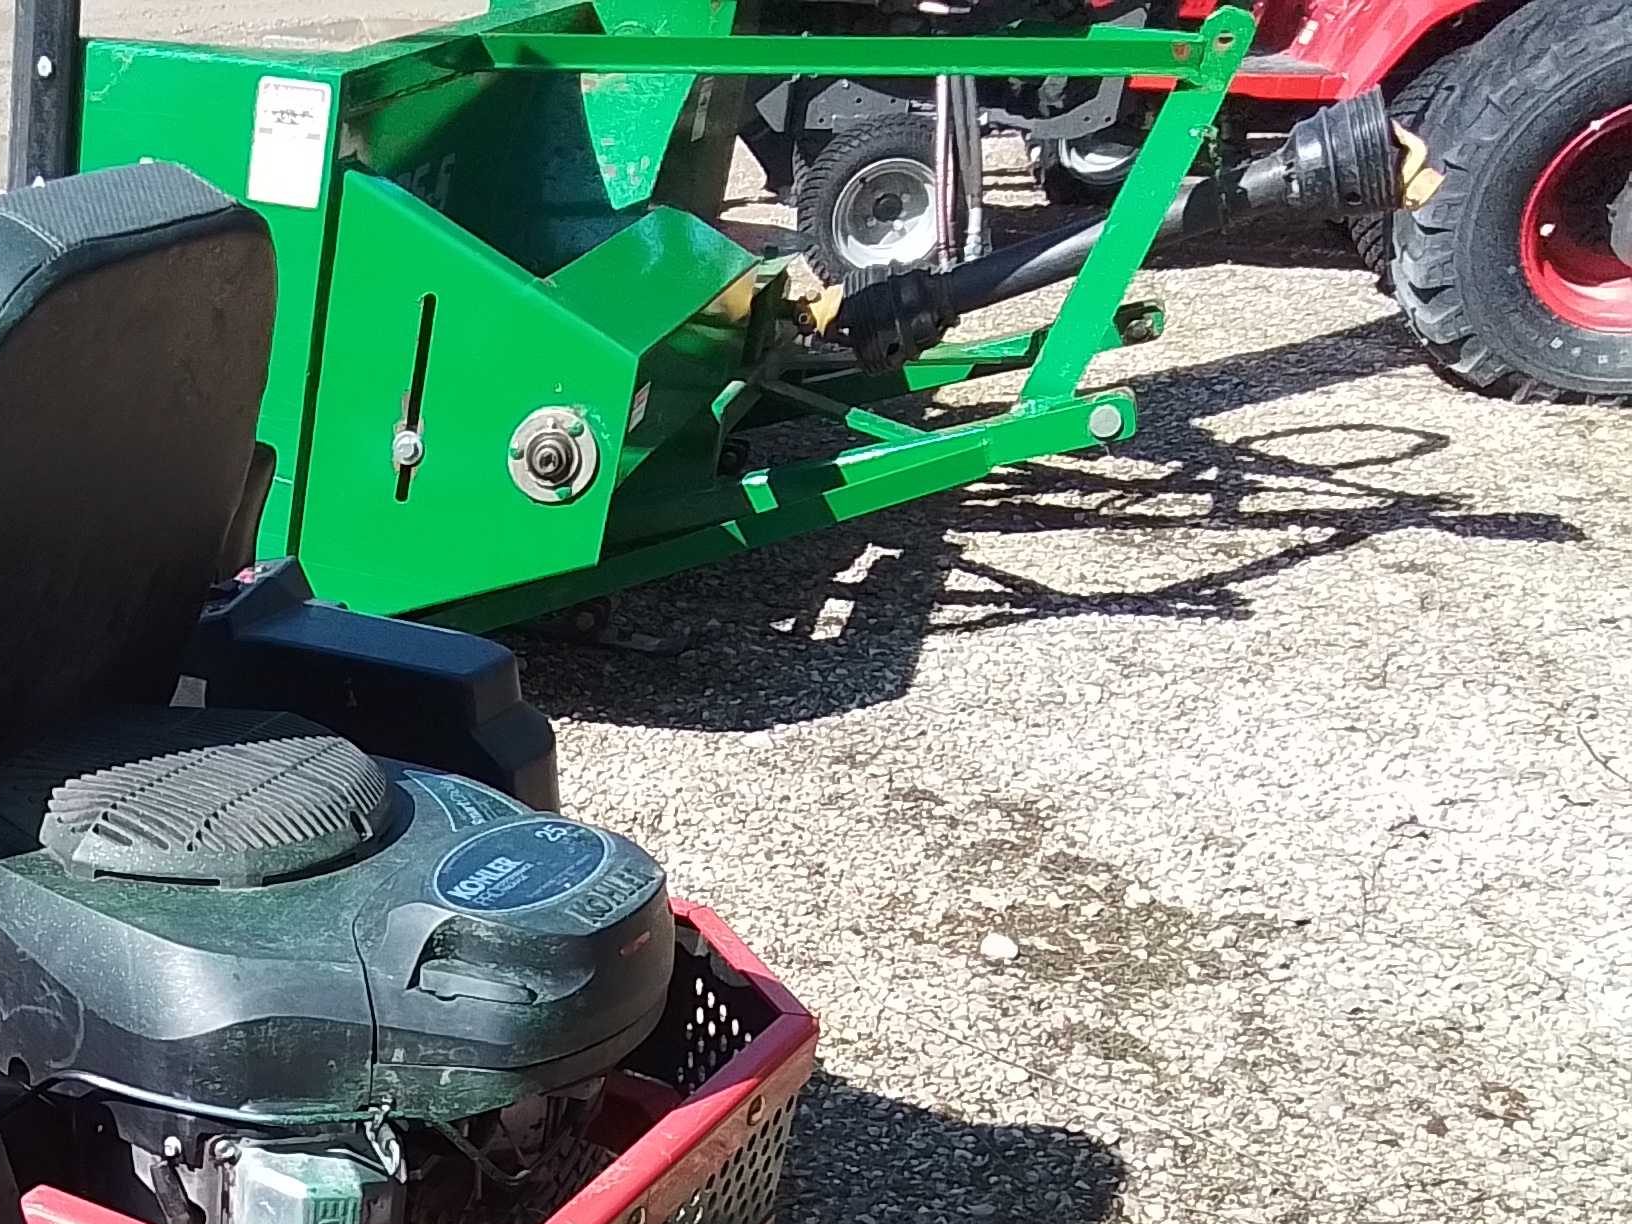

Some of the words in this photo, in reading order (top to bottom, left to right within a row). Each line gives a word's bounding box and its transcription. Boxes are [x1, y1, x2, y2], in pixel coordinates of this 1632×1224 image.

[535, 824, 568, 842] 25
[447, 856, 525, 901] KOHLER
[567, 868, 657, 926] KOHLER
